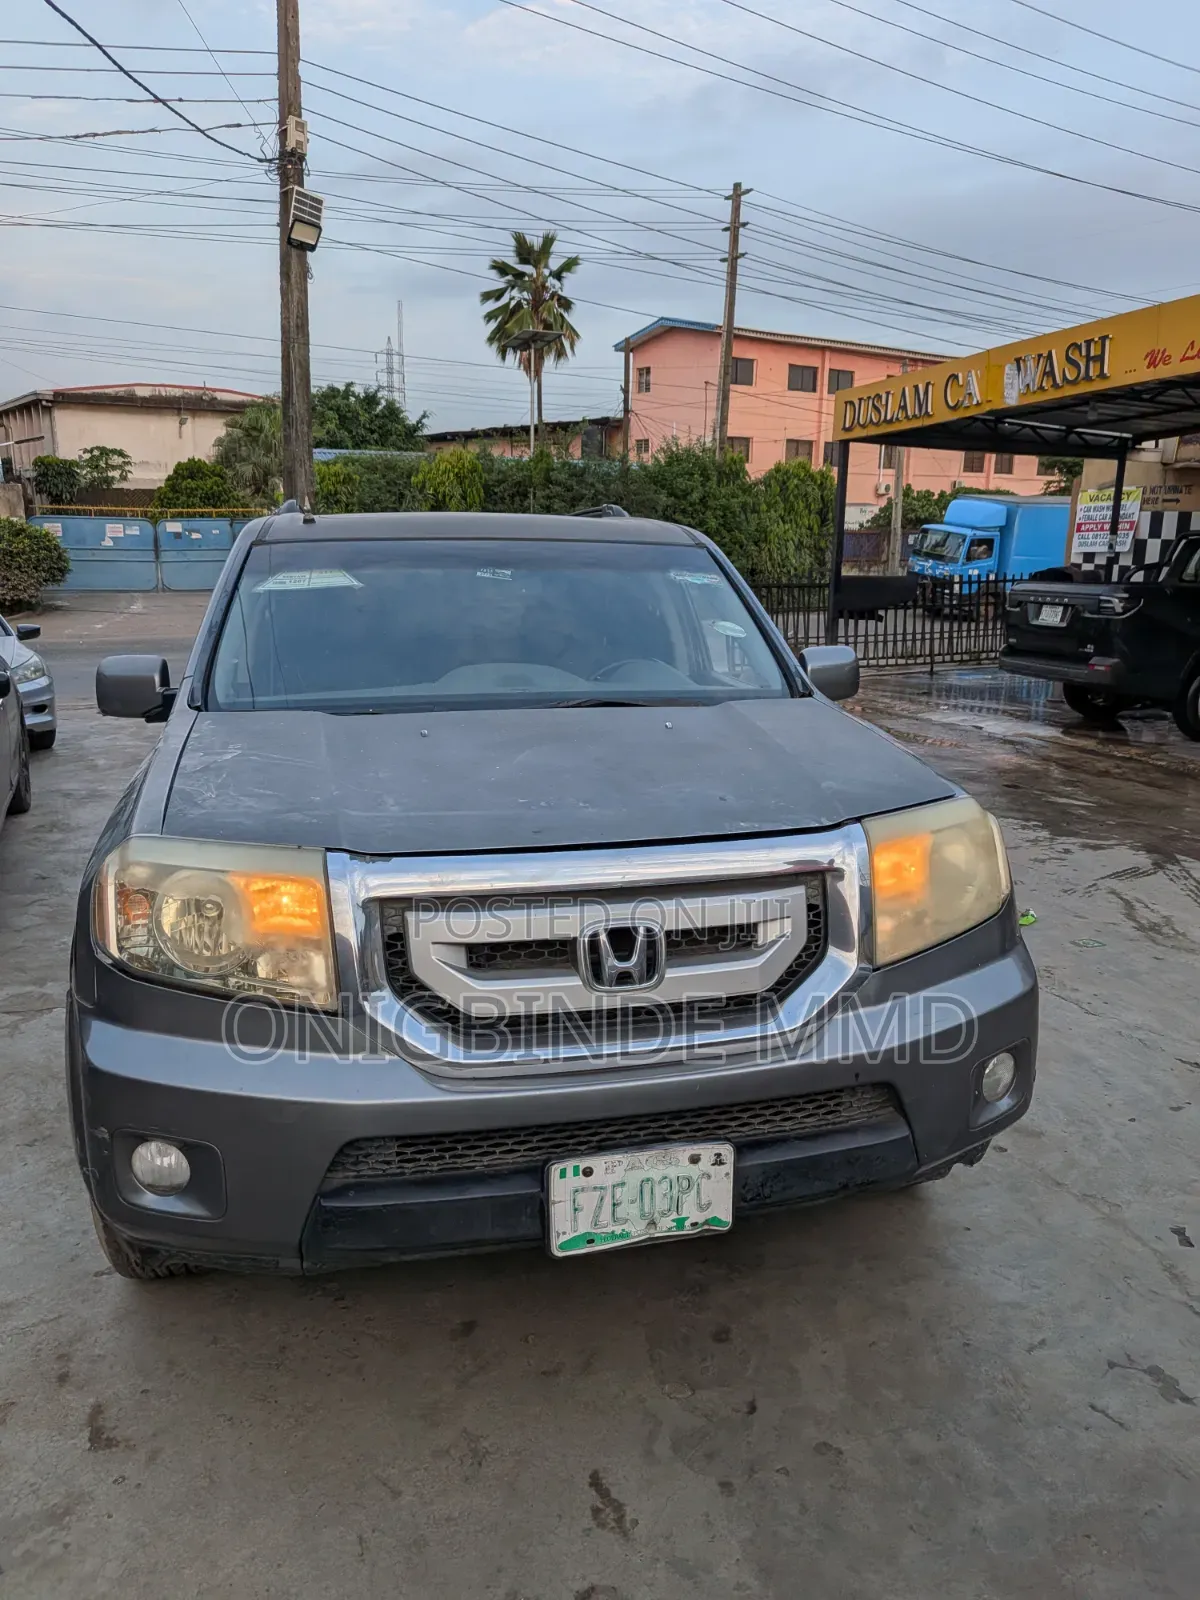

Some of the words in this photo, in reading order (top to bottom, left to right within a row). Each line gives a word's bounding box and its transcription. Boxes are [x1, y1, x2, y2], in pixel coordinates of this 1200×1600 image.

[1143, 347, 1172, 370] We
[1179, 340, 1200, 363] L
[841, 380, 935, 432] DUSLAM
[944, 367, 992, 410] CA
[1014, 334, 1112, 394] WASH
[1088, 491, 1133, 503] VACACY
[1080, 523, 1102, 531] APPLY
[1103, 522, 1130, 531] WHIN
